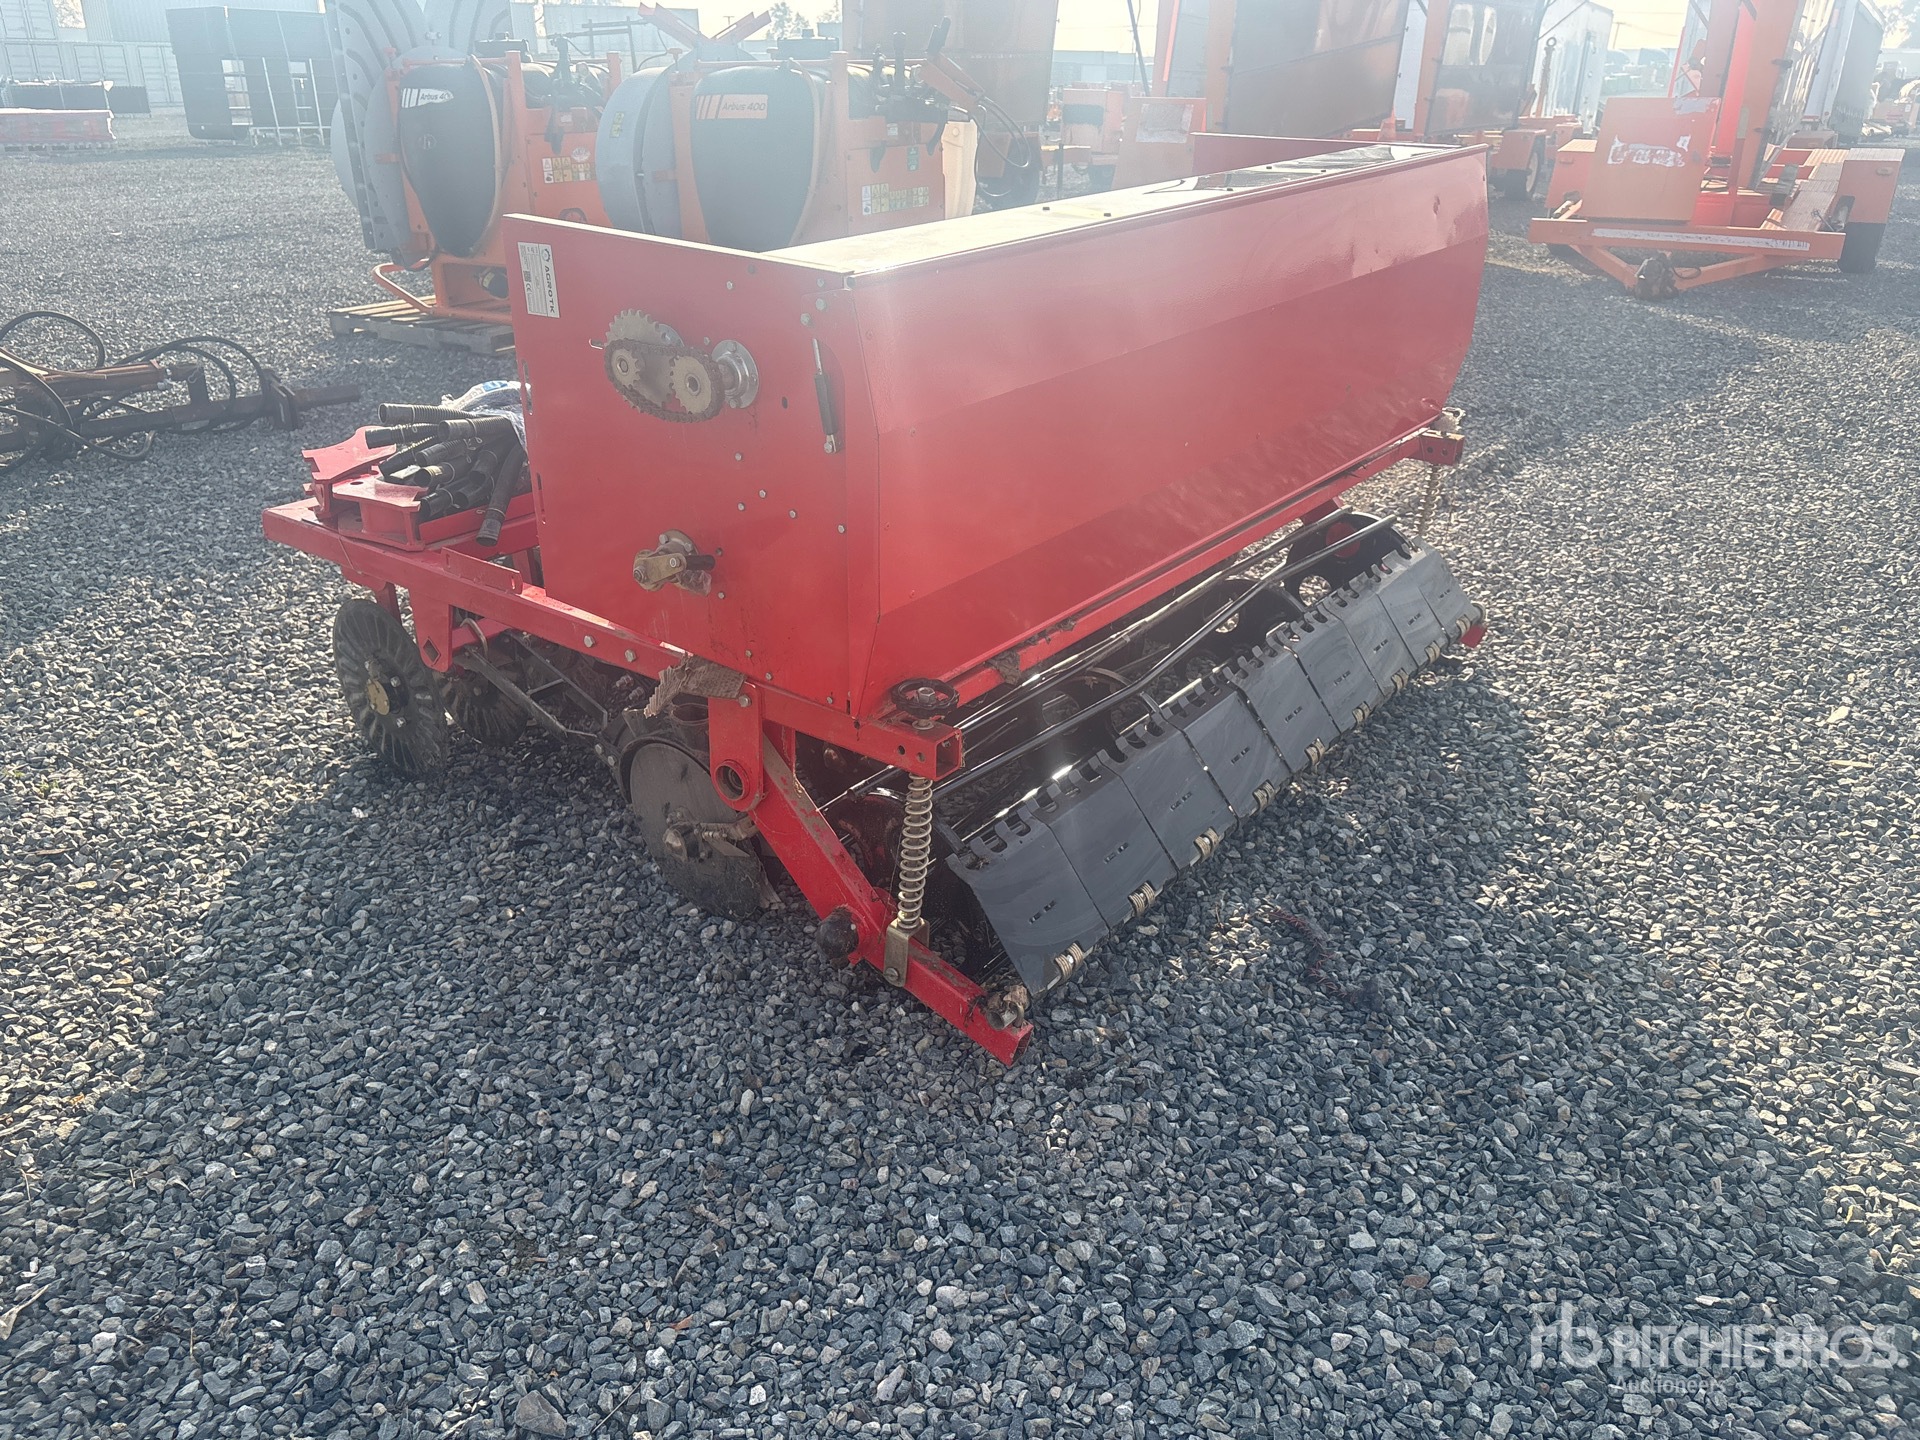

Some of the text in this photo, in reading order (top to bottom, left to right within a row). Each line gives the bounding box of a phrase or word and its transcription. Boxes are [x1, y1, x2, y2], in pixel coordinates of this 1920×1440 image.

[721, 102, 766, 111] Arbus 400
[544, 265, 555, 314] AGROTK
